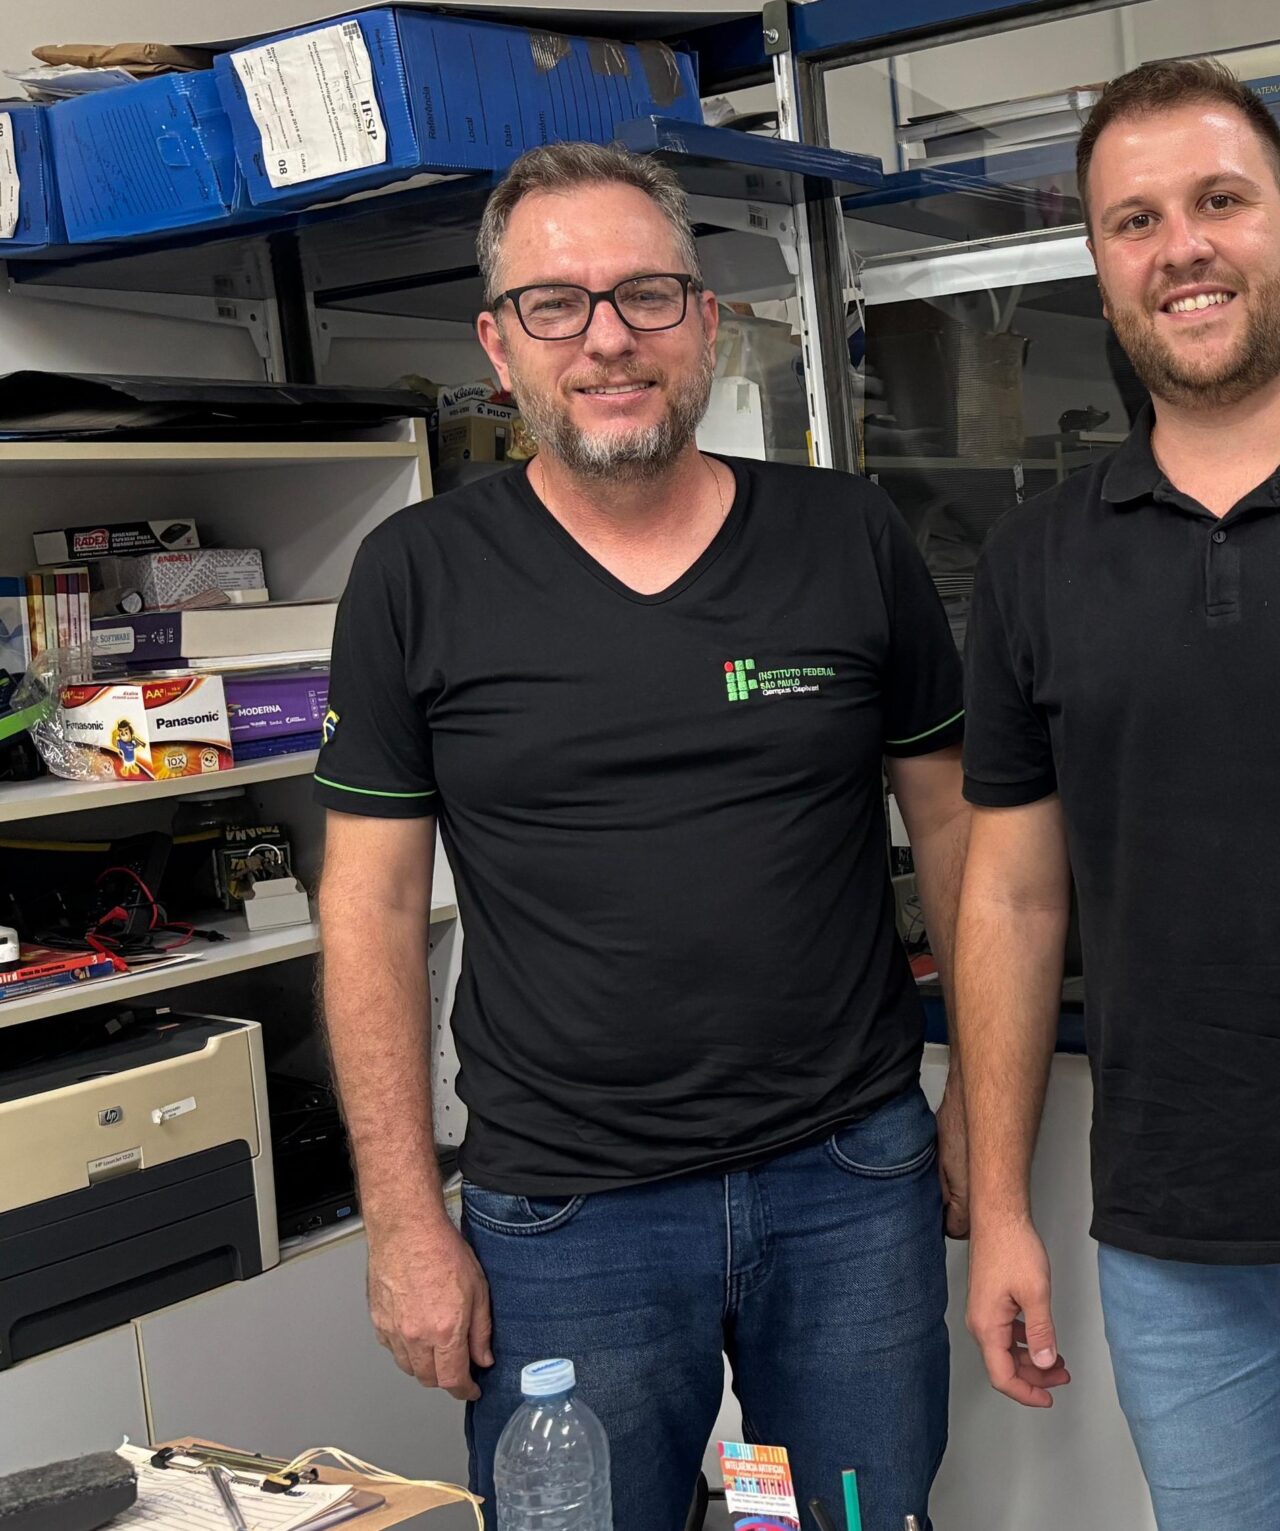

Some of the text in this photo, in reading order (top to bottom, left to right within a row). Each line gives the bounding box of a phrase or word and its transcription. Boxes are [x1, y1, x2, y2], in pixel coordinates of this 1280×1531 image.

[422, 86, 436, 139] Referência
[360, 99, 378, 141] IFSP
[465, 117, 475, 143] Local
[538, 111, 547, 145] ontém:
[278, 159, 288, 175] 08
[454, 387, 485, 401] Kleenex
[487, 408, 511, 419] PILOT
[75, 535, 107, 547] RADEX
[157, 554, 192, 564] ANDELI
[101, 633, 130, 643] SOFTWARE
[759, 667, 836, 681] INSTITUTO FEDERAL
[760, 679, 800, 690] SÃO PAULO
[762, 685, 819, 695] Campus Capivari
[238, 705, 281, 716] MODERNA
[65, 720, 104, 730] Panasonic
[156, 711, 219, 729] Panasonic
[167, 757, 185, 767] 10X
[105, 1109, 118, 1123] hp
[95, 1161, 102, 1169] HP
[758, 1464, 785, 1474] ARTIFICIAL
